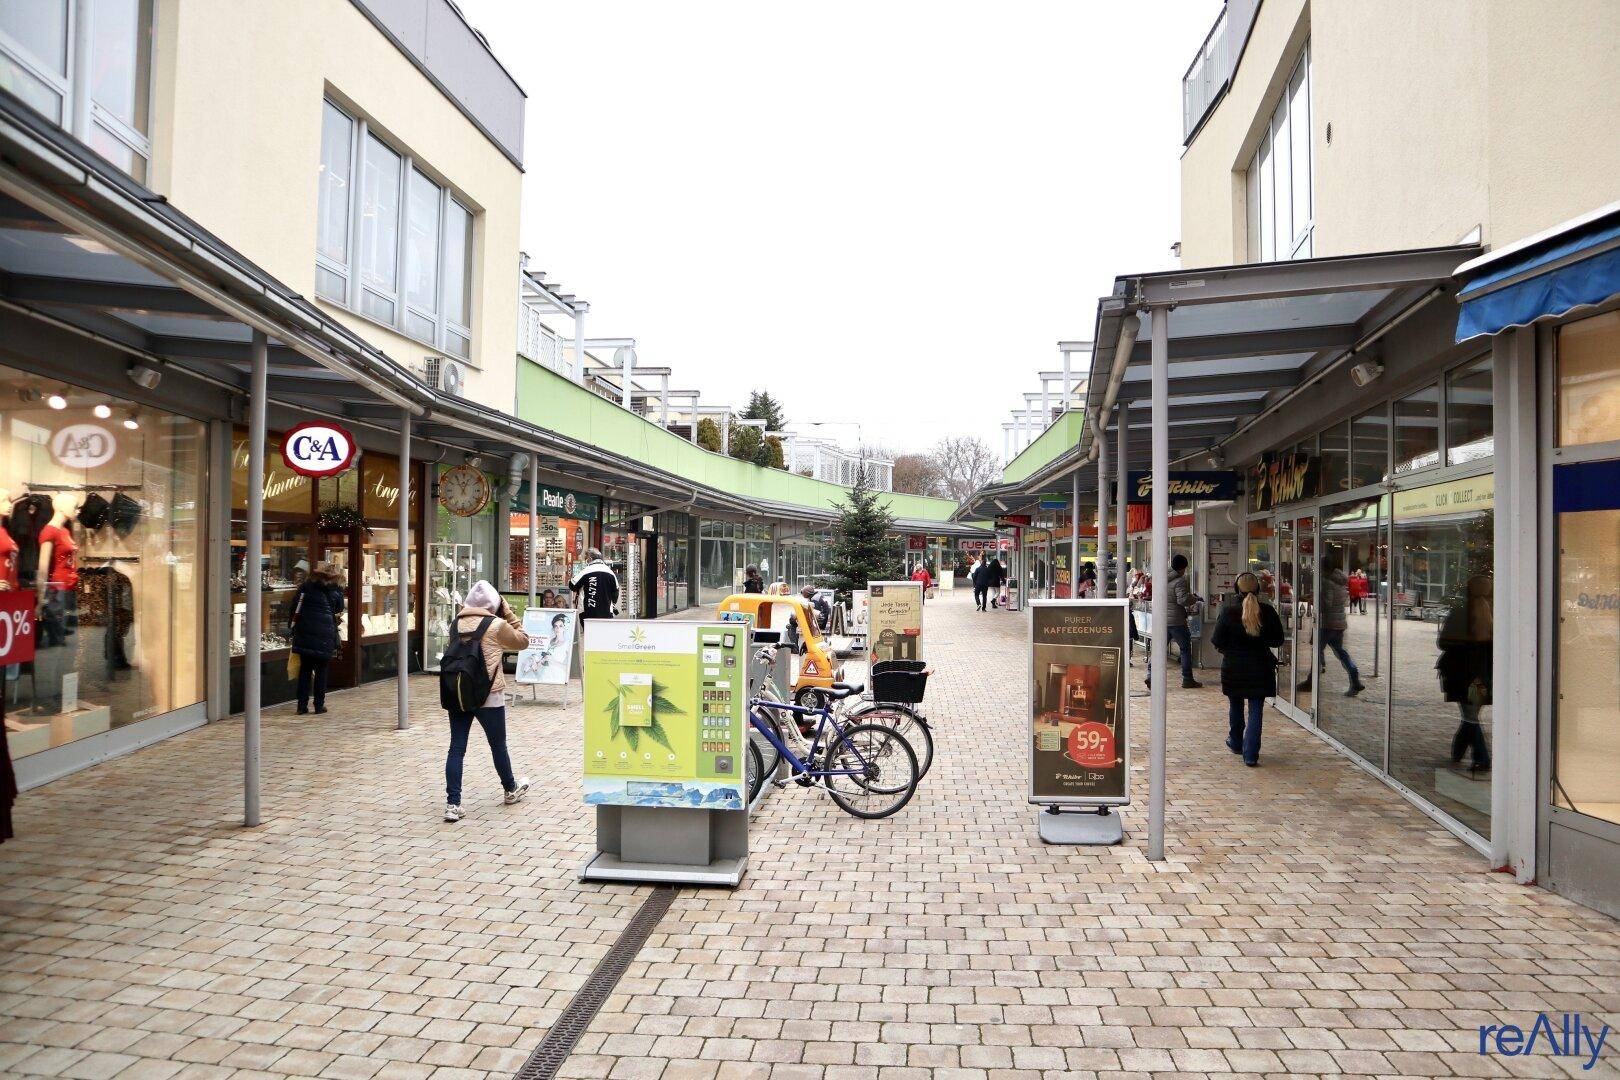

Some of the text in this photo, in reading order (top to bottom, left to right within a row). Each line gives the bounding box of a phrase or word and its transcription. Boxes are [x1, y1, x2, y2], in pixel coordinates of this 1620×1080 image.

[293, 436, 341, 461] C&A
[1167, 480, 1219, 493] Tchibo
[543, 489, 564, 508] Pearle
[961, 541, 996, 549] ruefa
[1064, 616, 1092, 624] PURER
[1043, 626, 1113, 635] KAFFEEGENUSS
